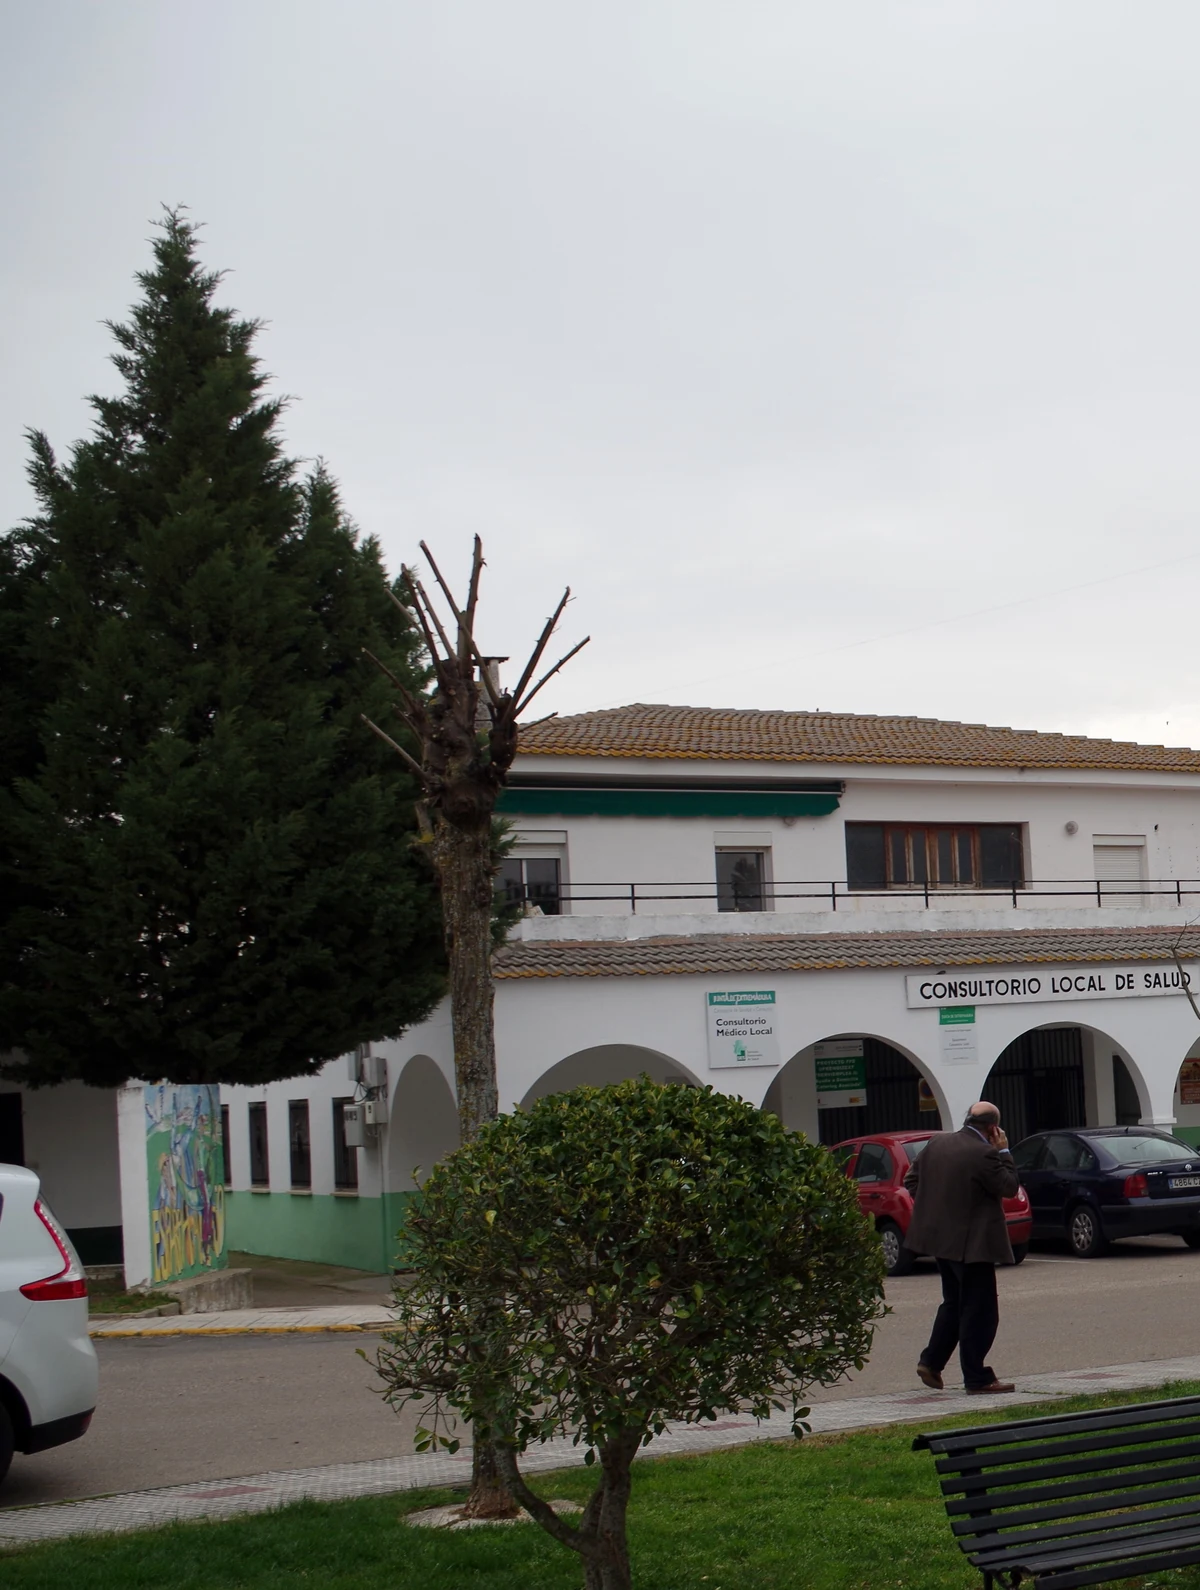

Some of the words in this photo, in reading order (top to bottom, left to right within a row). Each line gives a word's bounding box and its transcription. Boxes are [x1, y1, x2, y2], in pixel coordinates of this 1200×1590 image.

[919, 977, 1041, 1000] CONSULTORIO
[1051, 975, 1106, 994] LOCAL
[1115, 973, 1135, 991] DE
[1143, 971, 1192, 990] SALUD
[715, 1017, 767, 1027] Consultorio
[716, 1028, 748, 1037] Médico
[749, 1027, 773, 1036] Local
[1174, 1177, 1192, 1187] 4864
